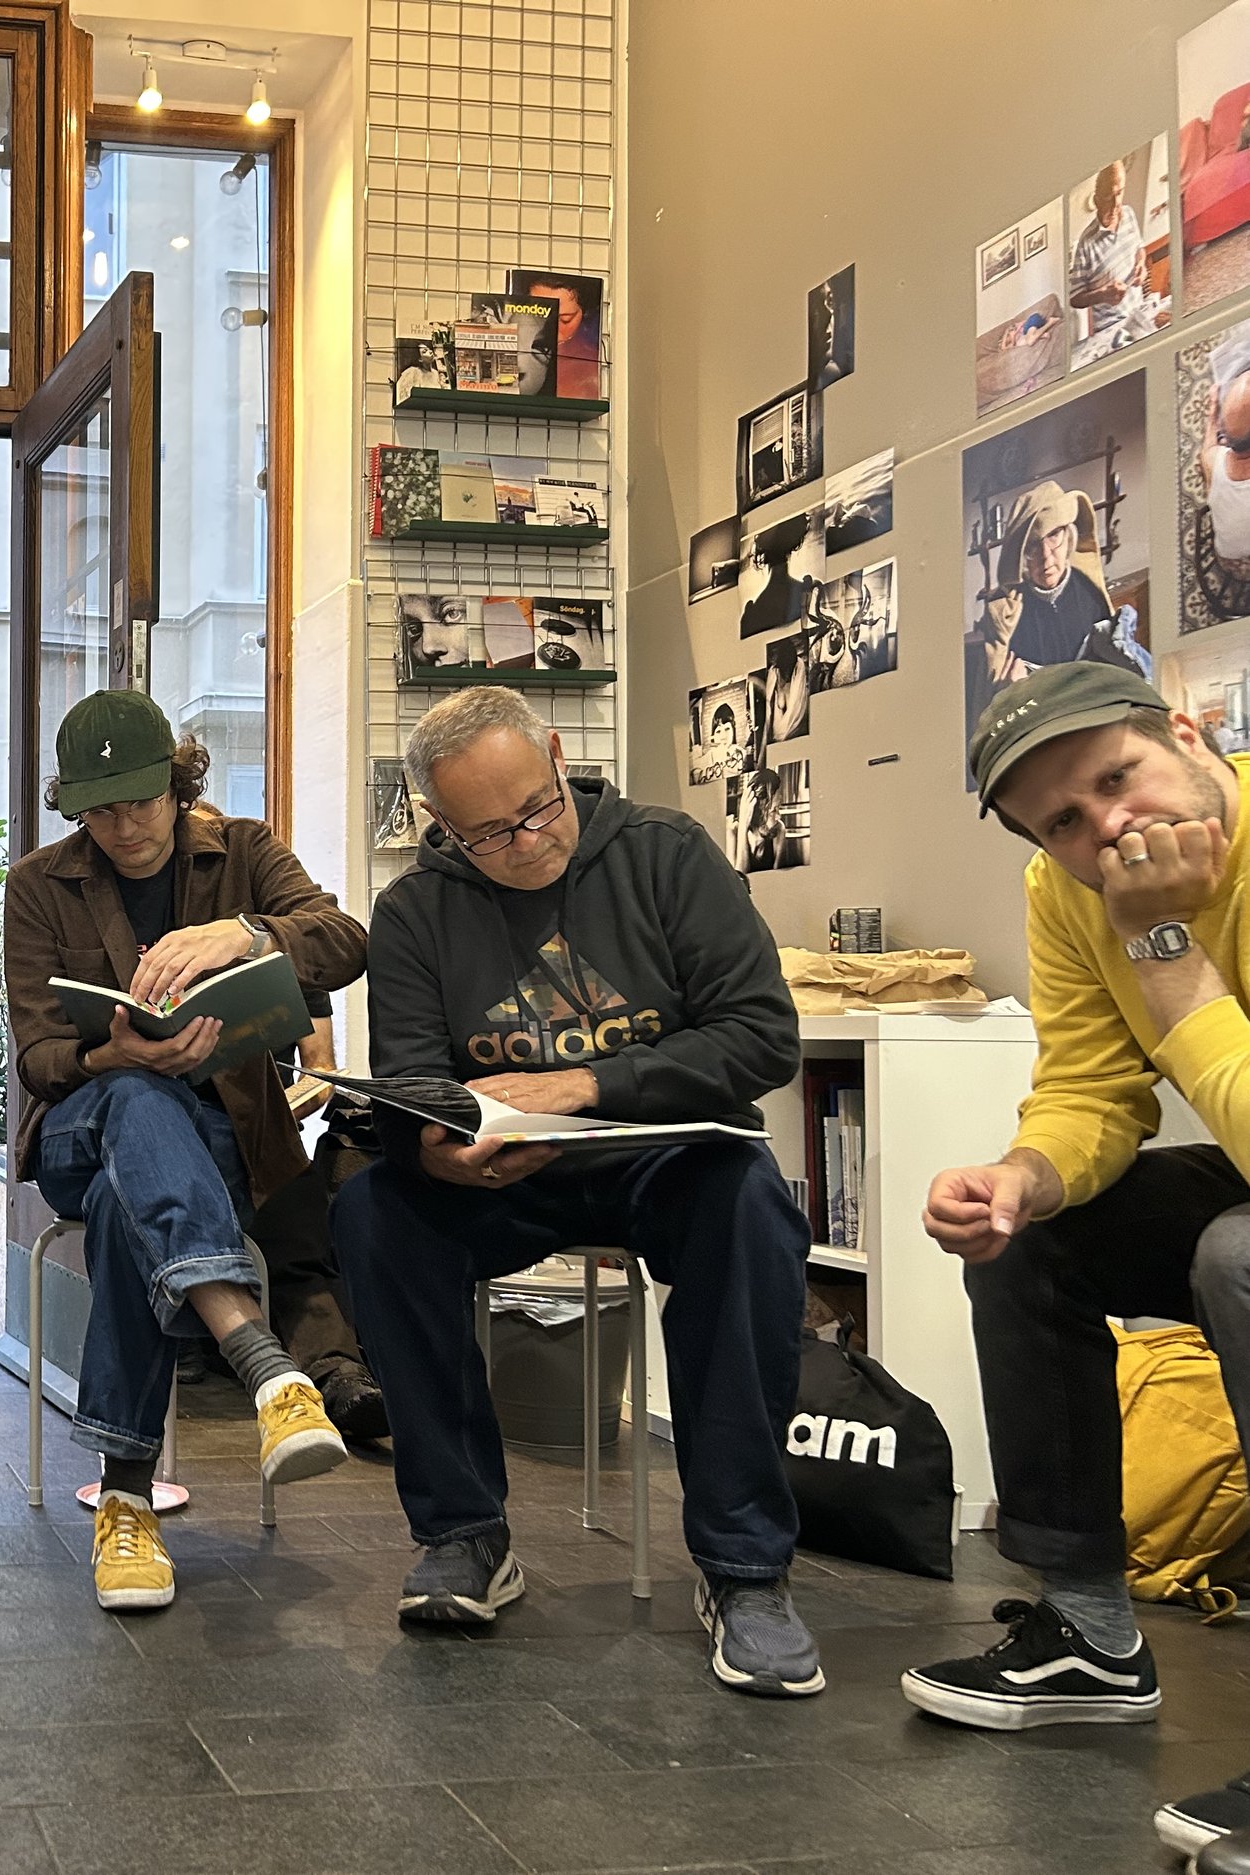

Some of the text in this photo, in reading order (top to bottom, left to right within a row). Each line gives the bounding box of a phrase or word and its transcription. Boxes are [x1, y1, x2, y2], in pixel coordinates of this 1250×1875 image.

[504, 303, 551, 318] monday
[467, 1008, 662, 1065] adidas
[786, 1412, 897, 1469] am
